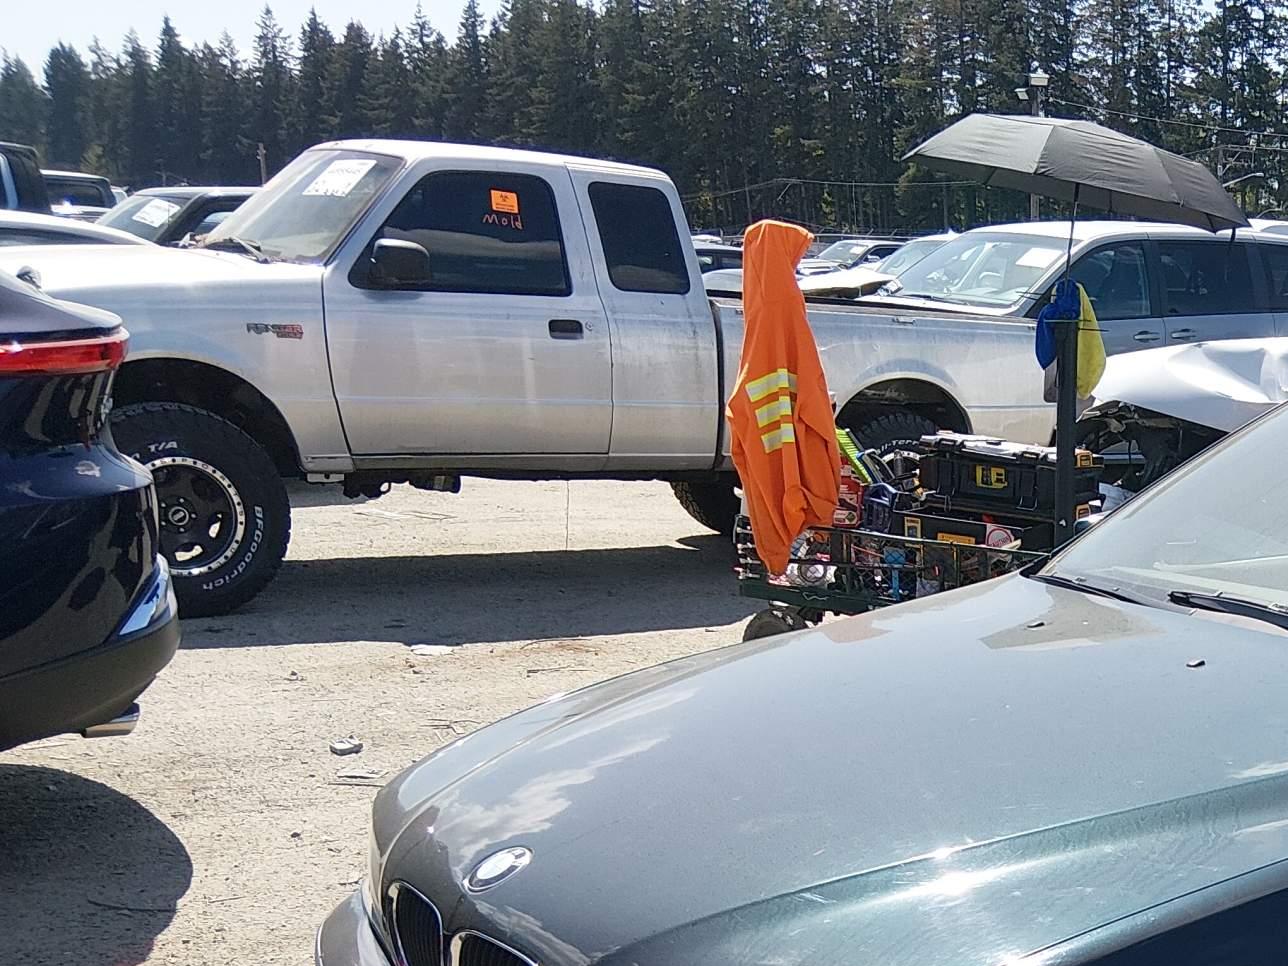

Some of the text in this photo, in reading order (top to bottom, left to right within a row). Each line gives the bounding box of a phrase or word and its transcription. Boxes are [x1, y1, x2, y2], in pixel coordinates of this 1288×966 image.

[482, 214, 523, 230] Mold
[147, 441, 178, 452] T/A
[202, 505, 265, 591] BFGoodrich
